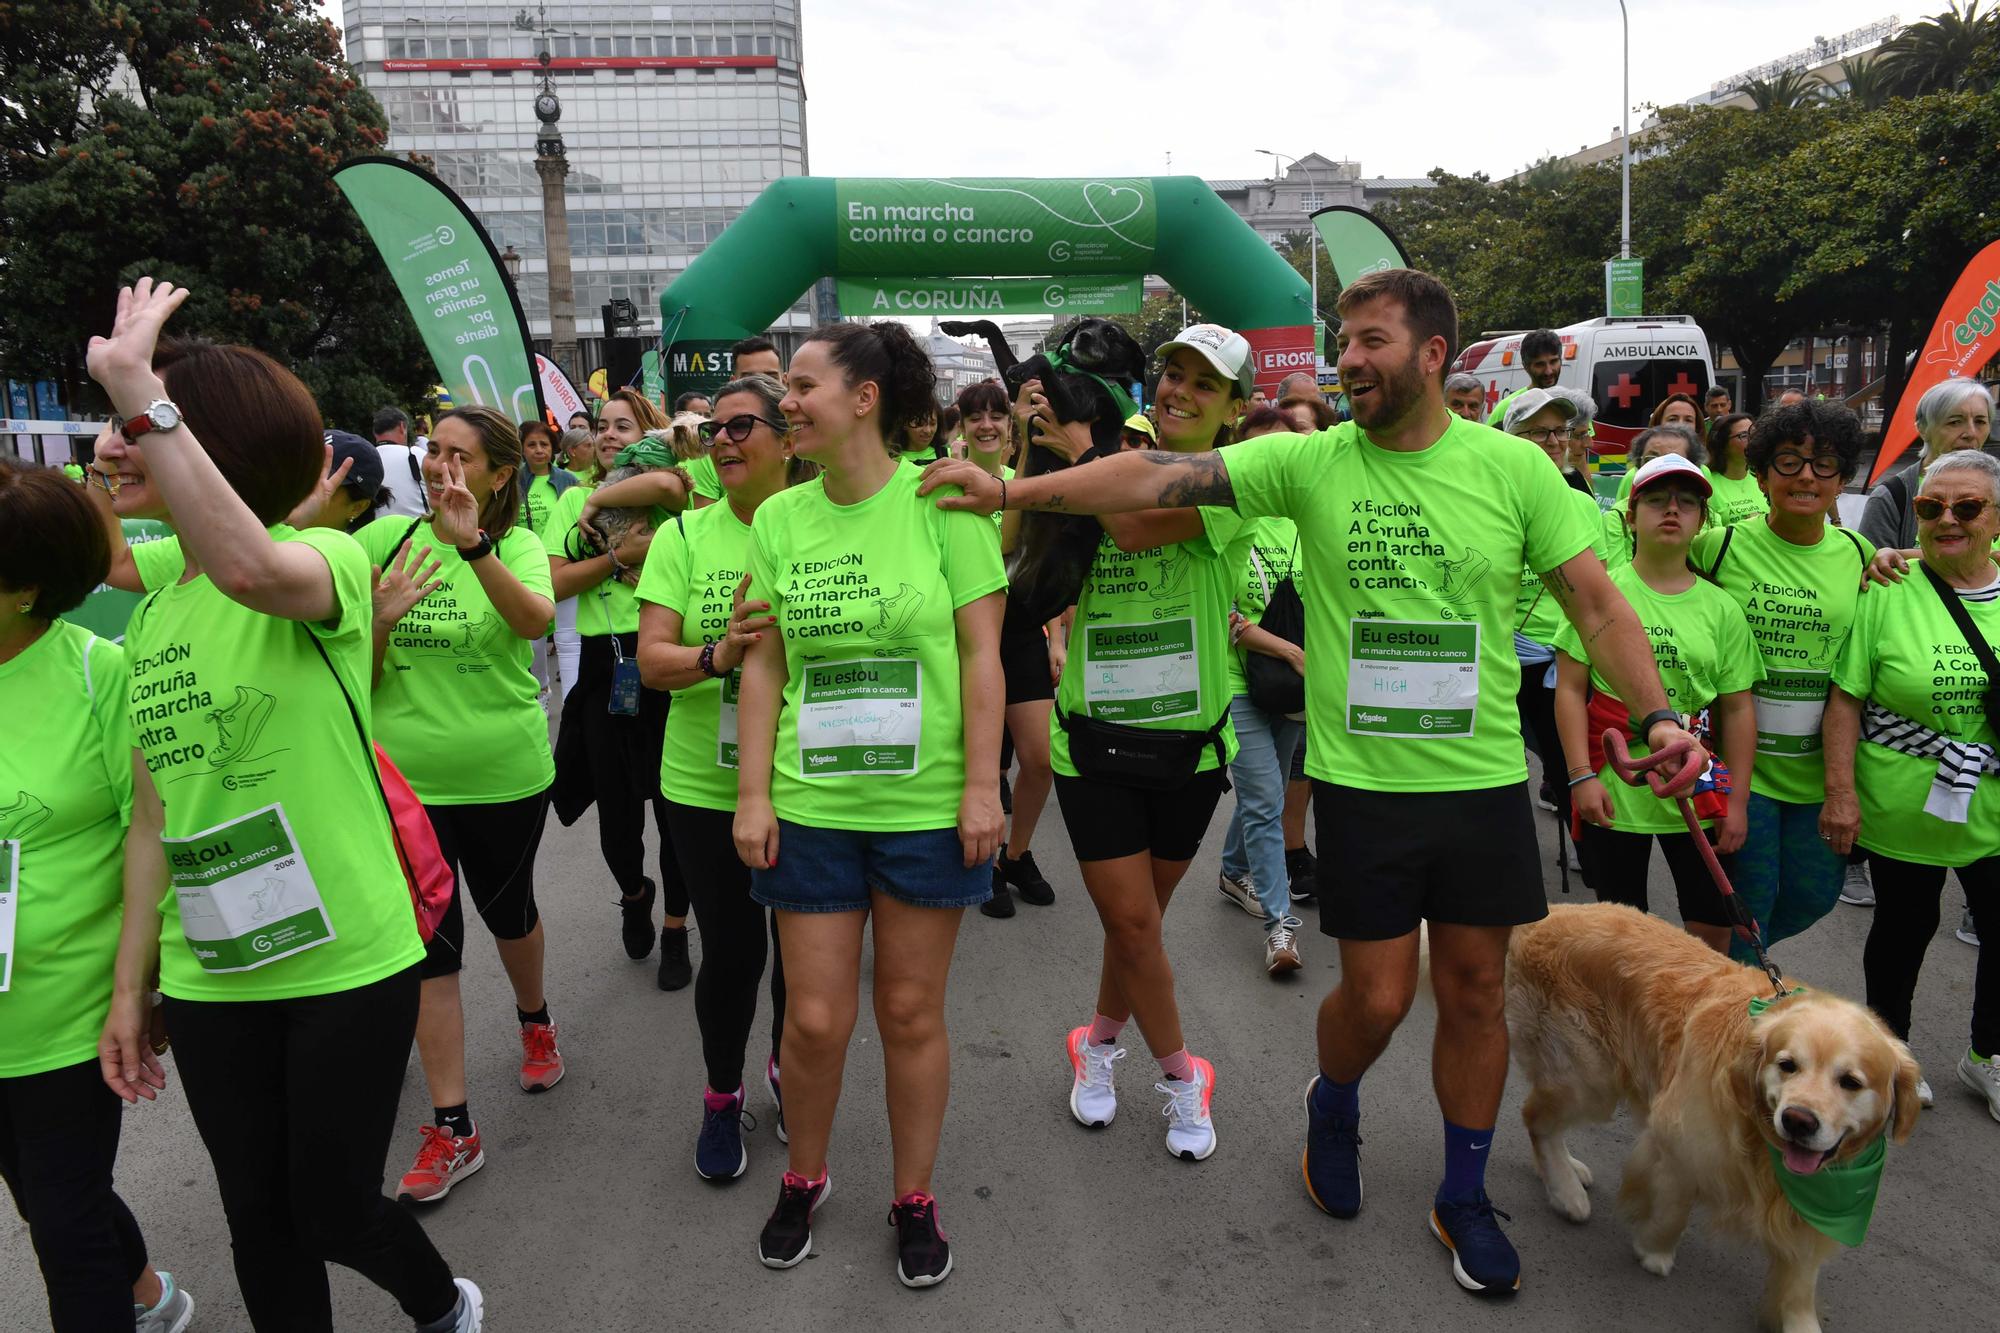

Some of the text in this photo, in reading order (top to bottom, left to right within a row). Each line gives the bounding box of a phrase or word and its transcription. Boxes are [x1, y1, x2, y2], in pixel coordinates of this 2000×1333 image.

[848, 202, 974, 221] En marcha
[850, 224, 1034, 243] contra o cancro
[872, 285, 1004, 309] A CORUÑA
[1604, 345, 1698, 358] AMBULANCIA
[1264, 352, 1314, 368] EROSKI
[1352, 500, 1362, 512] X
[1349, 520, 1361, 535] A
[1348, 541, 1370, 552] en
[790, 553, 863, 574] X EDICIÓN
[706, 572, 715, 582] X
[788, 572, 868, 592] A Coruña
[1350, 577, 1360, 589] o
[704, 588, 714, 598] A
[1098, 580, 1148, 594] cancro
[1750, 582, 1817, 600] X EDICIÓN
[420, 597, 457, 608] ruña
[784, 587, 881, 604] en marcha
[702, 604, 723, 614] en
[787, 604, 842, 620] contra
[1747, 597, 1822, 618] A Coruña
[787, 620, 864, 640] o cancro
[1746, 613, 1830, 632] en marcha
[1095, 630, 1160, 646] Eu estou
[1361, 628, 1440, 646] Eu estou
[1644, 624, 1673, 637] CIÓN
[1754, 629, 1795, 644] ontra
[394, 637, 451, 648] cancro
[1104, 648, 1128, 656] marcha
[1130, 646, 1153, 654] contra
[1160, 642, 1185, 650] cancro
[1652, 641, 1678, 656] uña
[1932, 644, 1942, 654] X
[1371, 648, 1400, 656] marcha
[1656, 656, 1688, 671] rcha
[1933, 660, 1946, 672] A
[814, 668, 879, 688] Eu estou
[1785, 677, 1824, 688] estou
[1932, 676, 1956, 686] en
[132, 670, 196, 704] Coruña
[821, 688, 846, 697] marcha
[847, 686, 870, 695] contra
[136, 691, 212, 726] marcha
[1932, 705, 1942, 714] o
[138, 726, 178, 750] ntra
[172, 841, 234, 867] estou
[195, 864, 228, 880] contra
[230, 860, 238, 868] o
[240, 844, 278, 865] cancro
[274, 858, 296, 871] 2006
